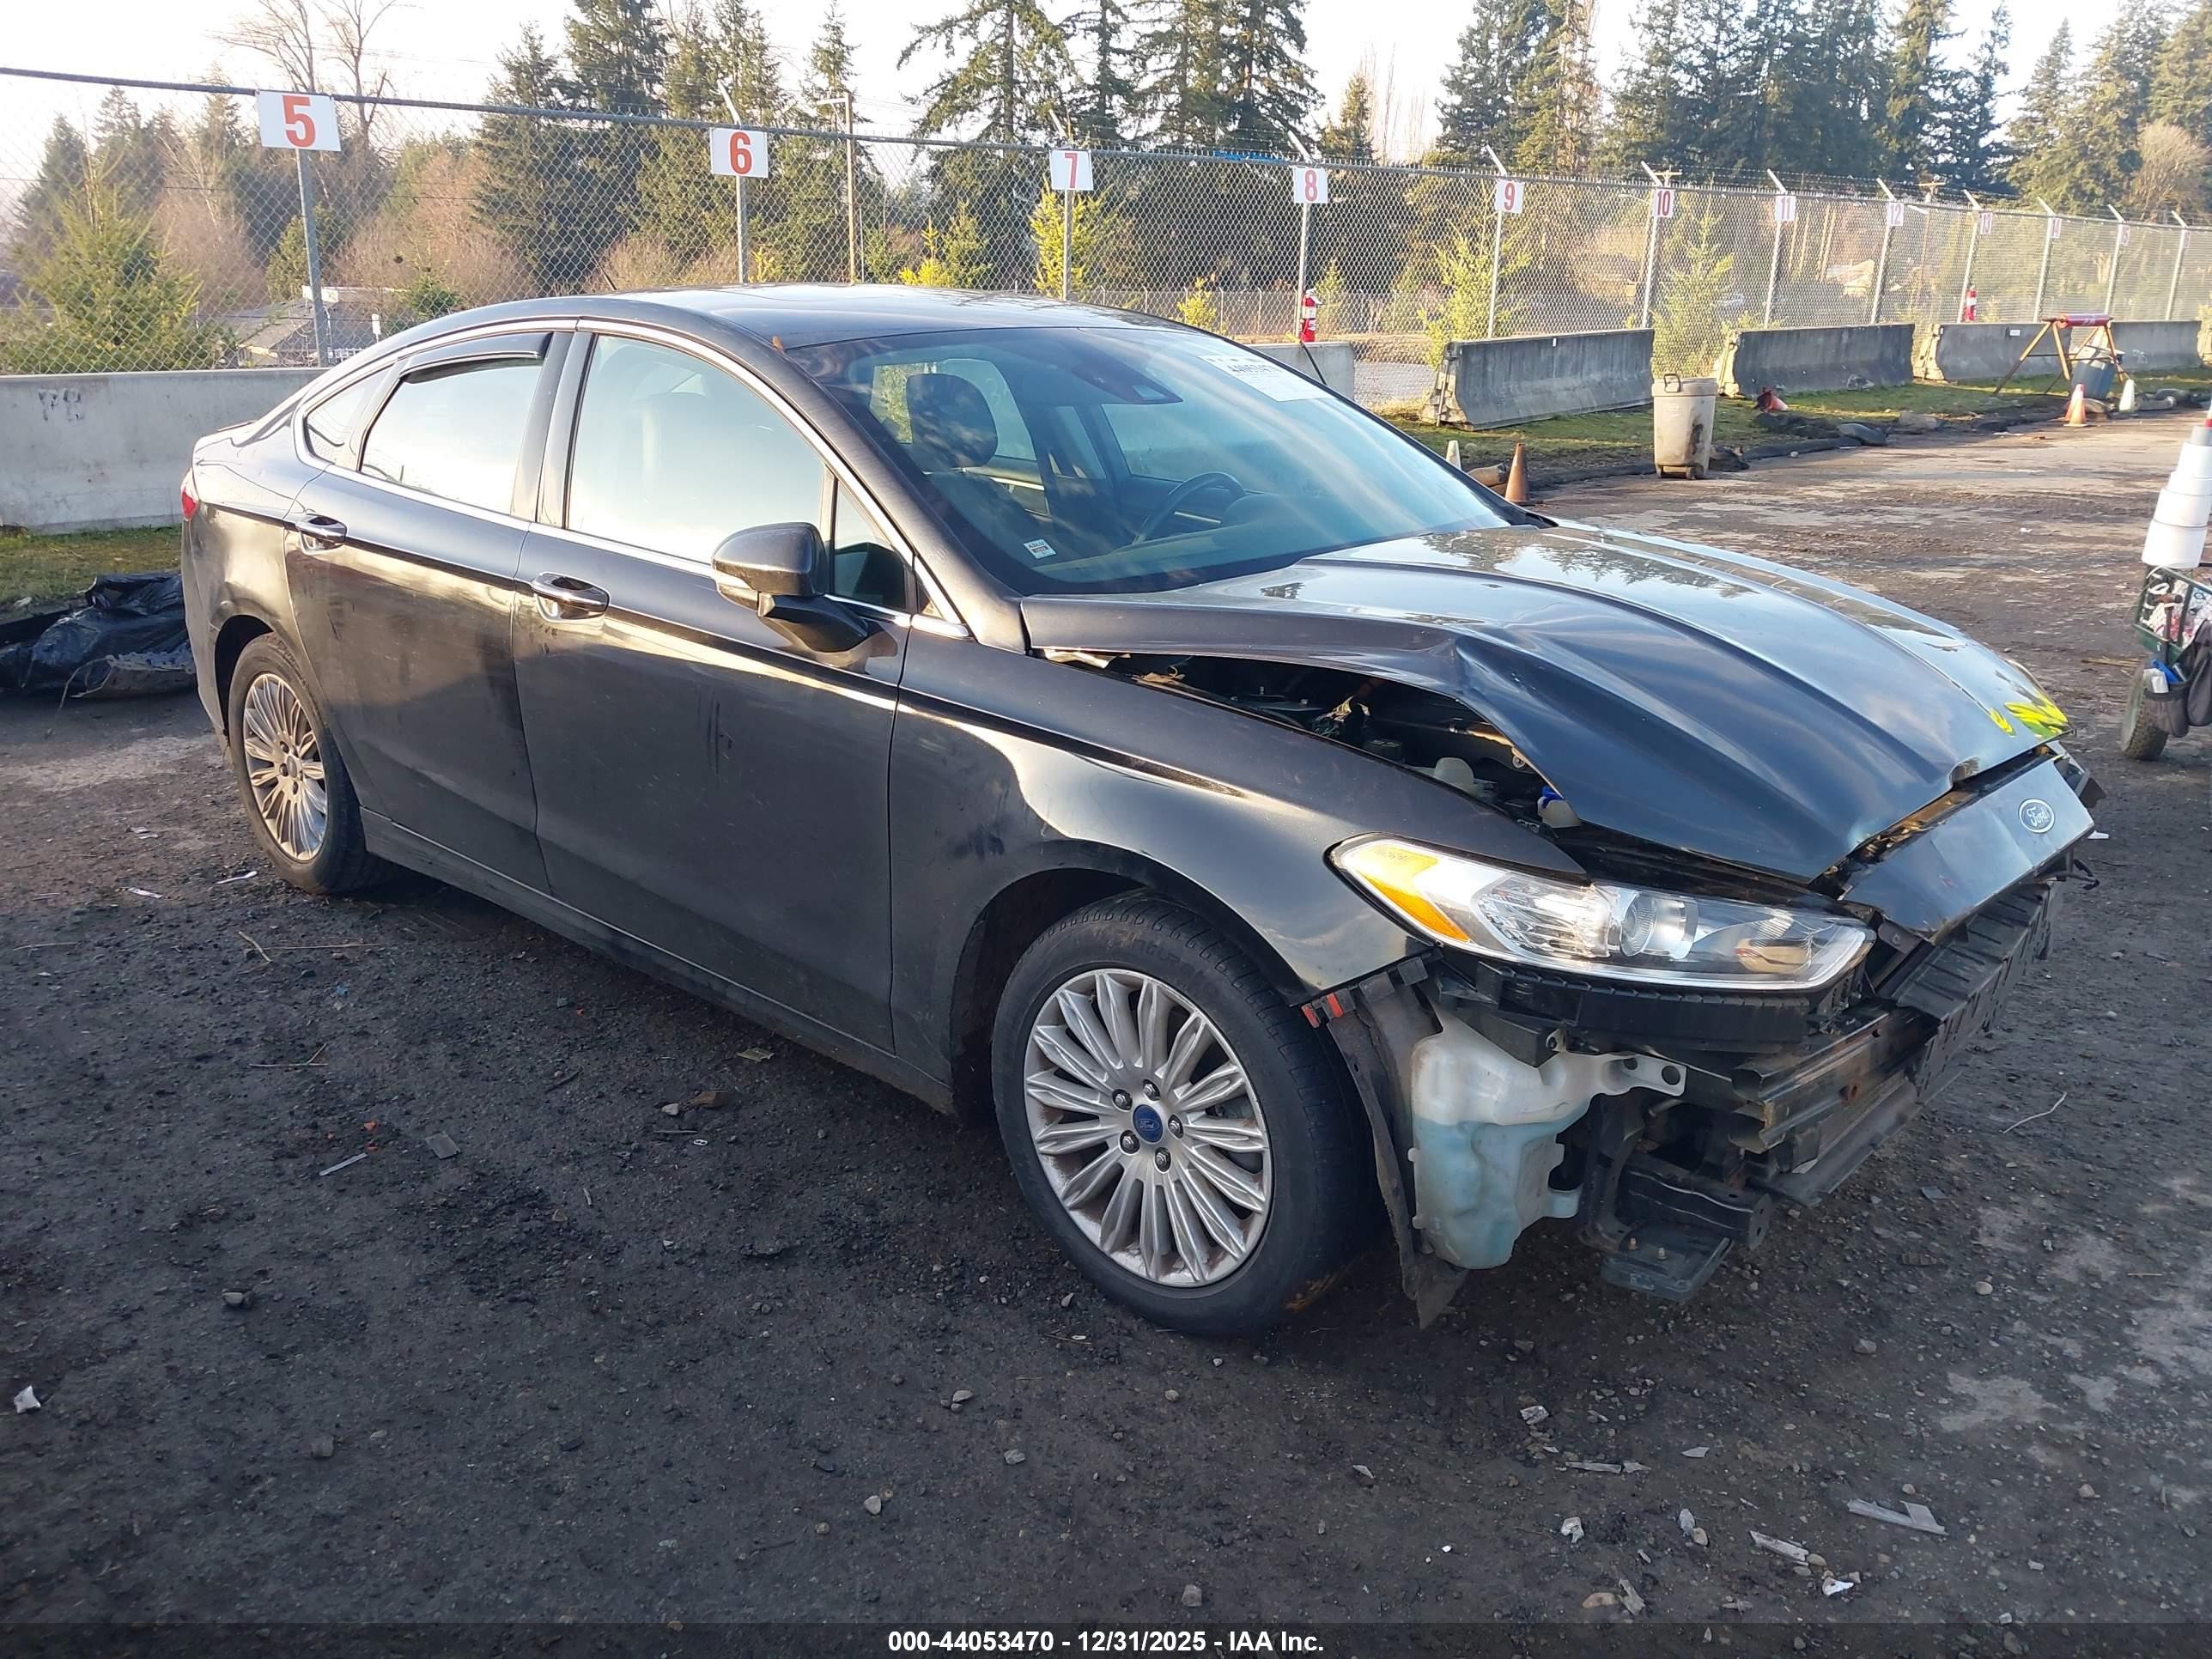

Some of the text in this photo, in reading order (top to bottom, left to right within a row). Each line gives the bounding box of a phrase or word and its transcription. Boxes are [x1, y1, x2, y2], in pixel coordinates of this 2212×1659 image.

[283, 95, 315, 147] 5
[729, 132, 753, 174] 6
[1065, 153, 1079, 187] 7
[1304, 170, 1317, 202] 8
[1504, 183, 1516, 210] 9
[1656, 190, 1671, 216] 10
[1780, 197, 1791, 221] 11
[1889, 203, 1902, 225] 12
[2026, 805, 2049, 827] Ford
